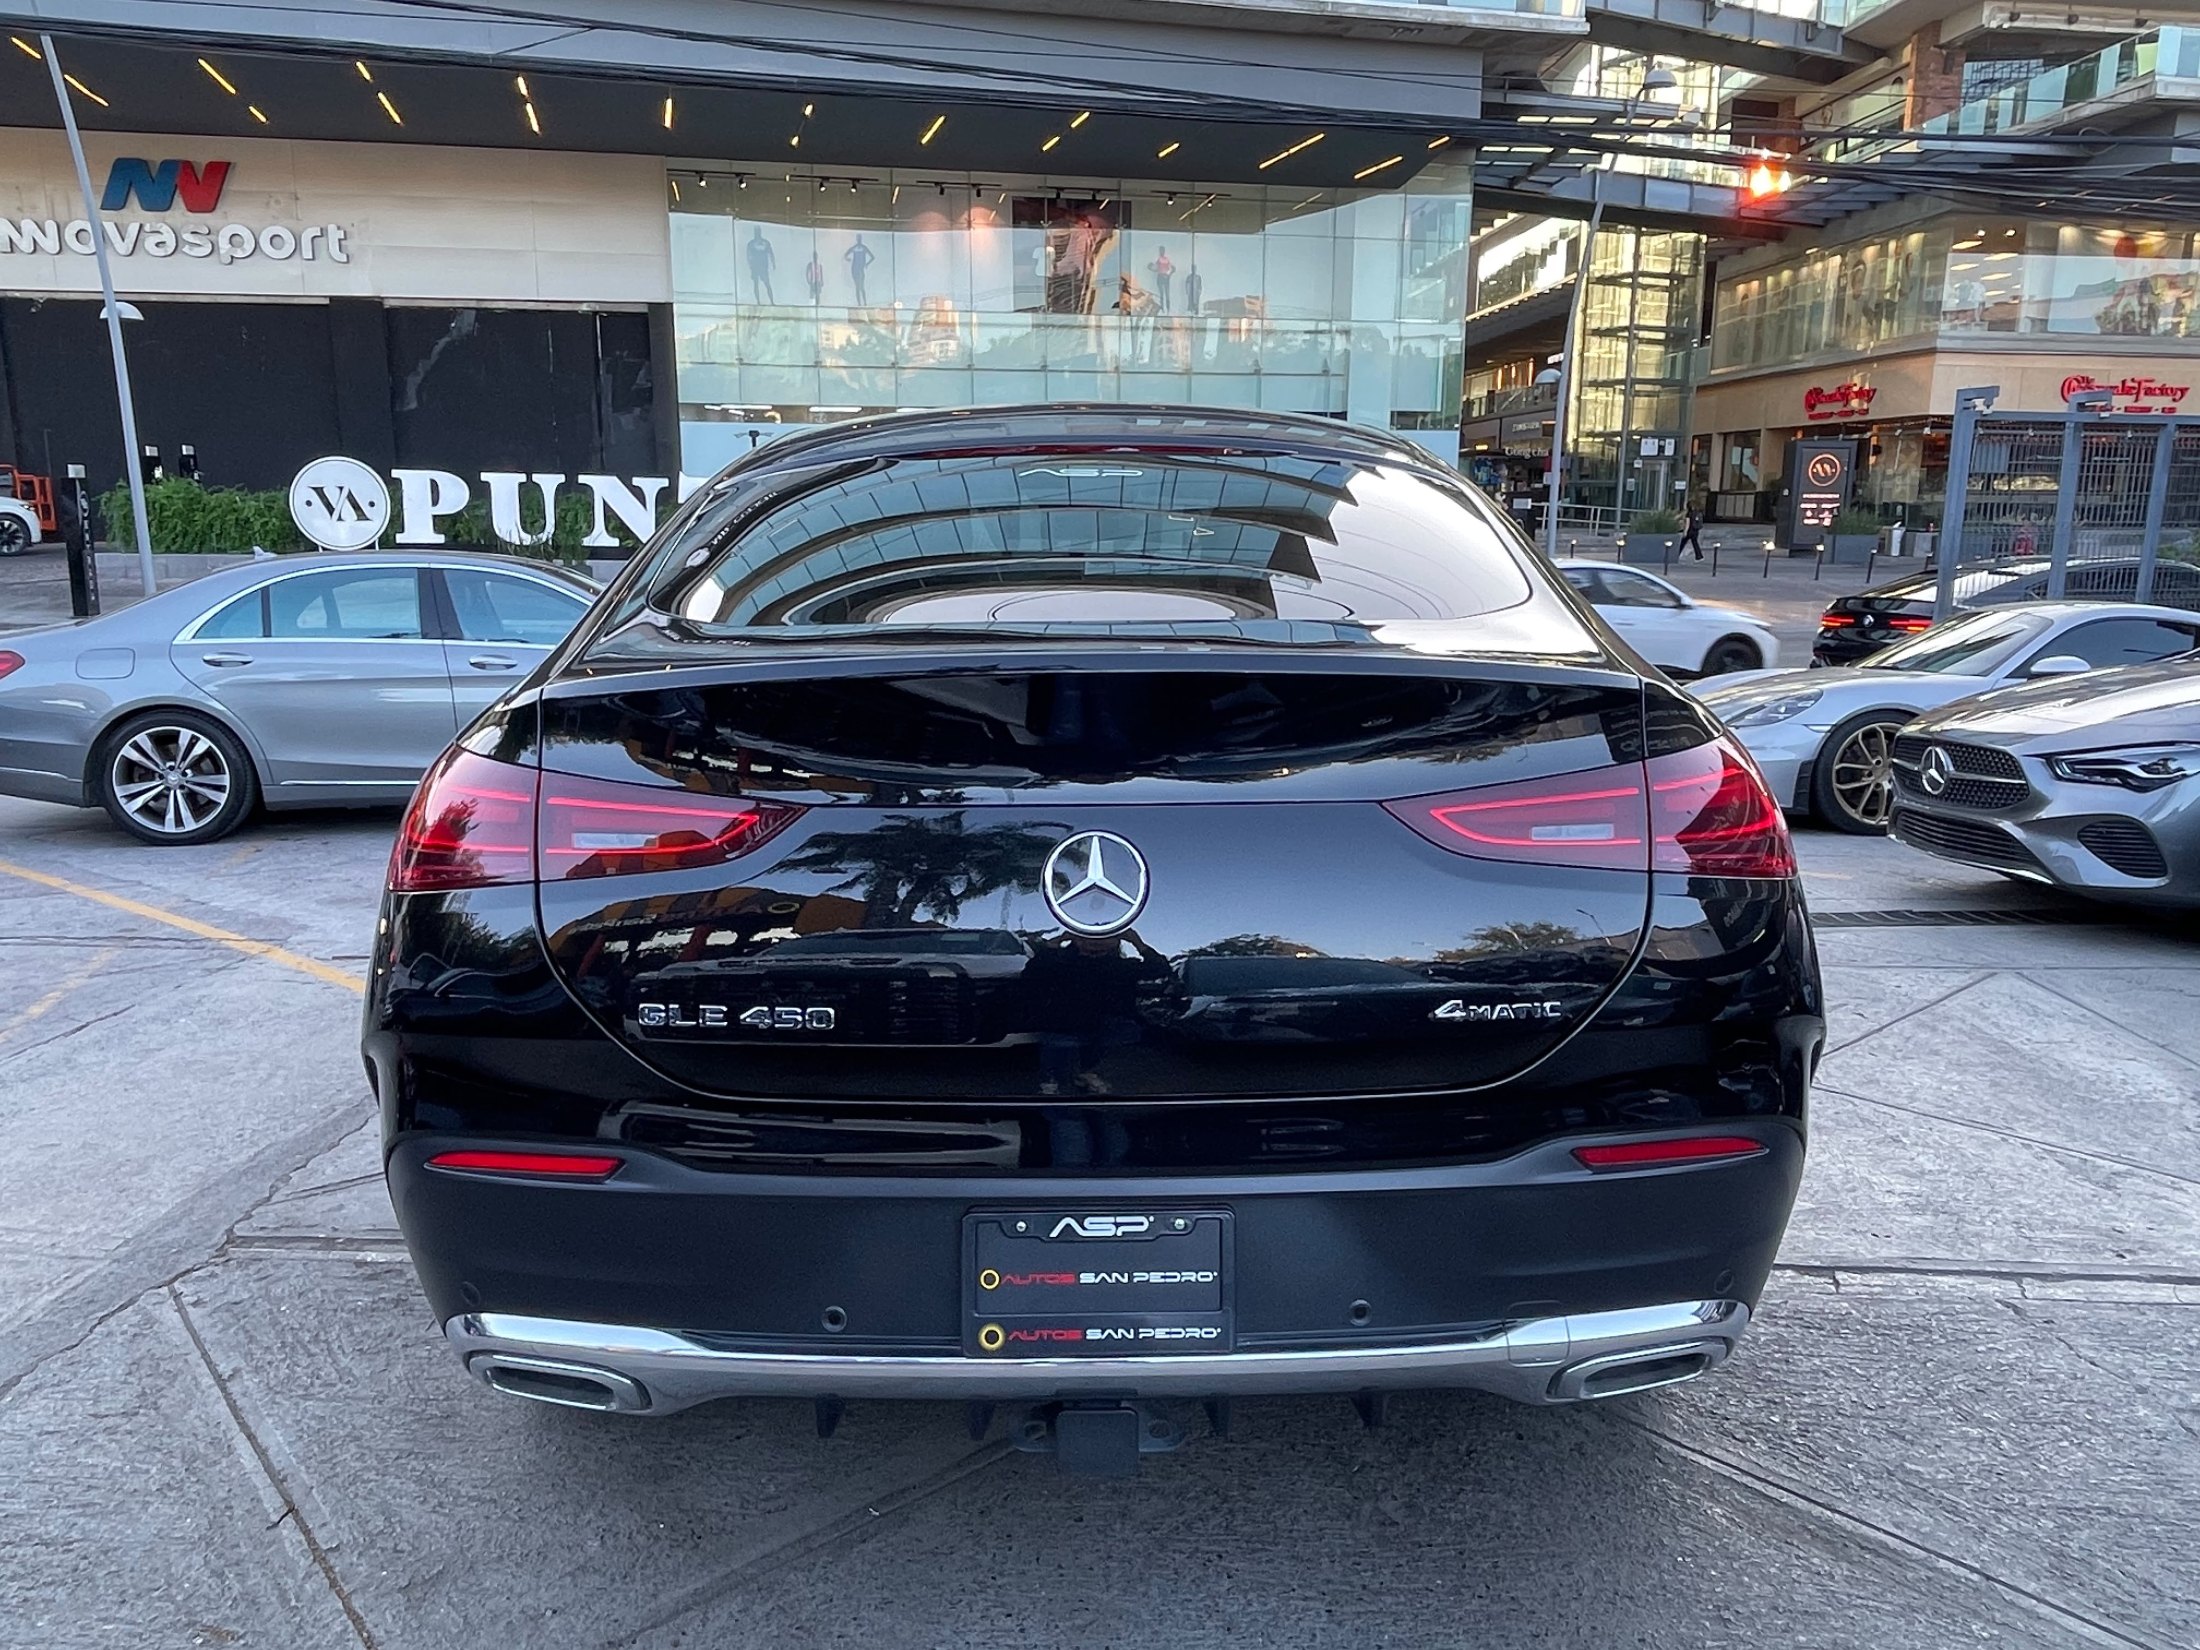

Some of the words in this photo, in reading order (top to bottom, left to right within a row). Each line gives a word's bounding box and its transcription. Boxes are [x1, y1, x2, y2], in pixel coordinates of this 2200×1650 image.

[638, 1003, 728, 1026] GLE
[739, 1006, 835, 1029] 450
[1434, 1000, 1562, 1021] 4MATIC
[1049, 1215, 1150, 1238] ASP
[1002, 1272, 1076, 1285] AUTOS
[1079, 1272, 1129, 1284] SAN
[1133, 1271, 1214, 1284] PEDRO
[1008, 1329, 1083, 1341] AUTOS
[1086, 1328, 1135, 1340] SAN
[1138, 1328, 1217, 1339] PEDRO
